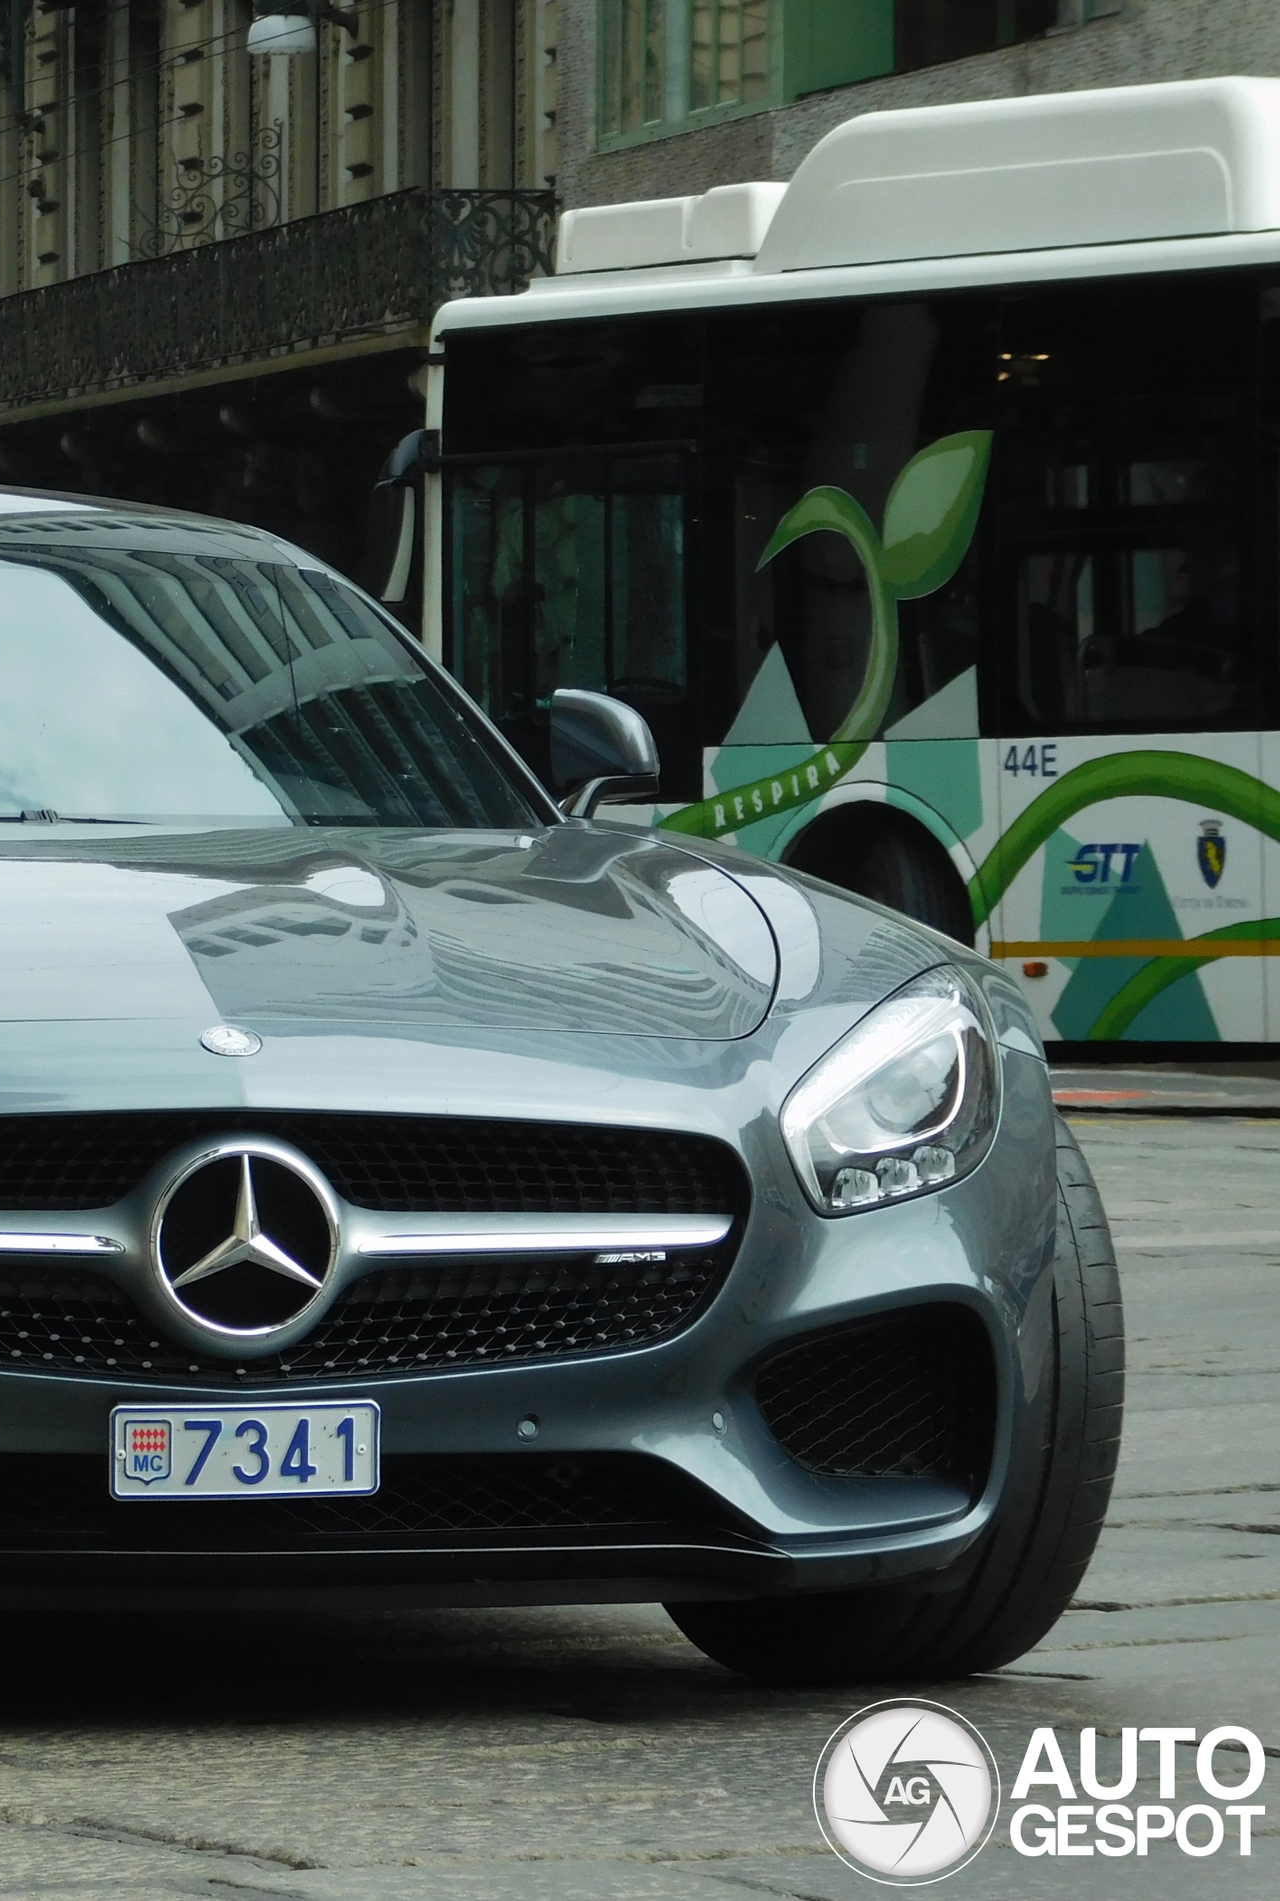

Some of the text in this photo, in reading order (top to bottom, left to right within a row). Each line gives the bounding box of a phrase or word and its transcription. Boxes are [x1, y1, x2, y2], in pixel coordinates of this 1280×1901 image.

[714, 751, 841, 830] RESPIRA
[1004, 744, 1058, 777] 44E
[184, 1417, 354, 1486] 7341
